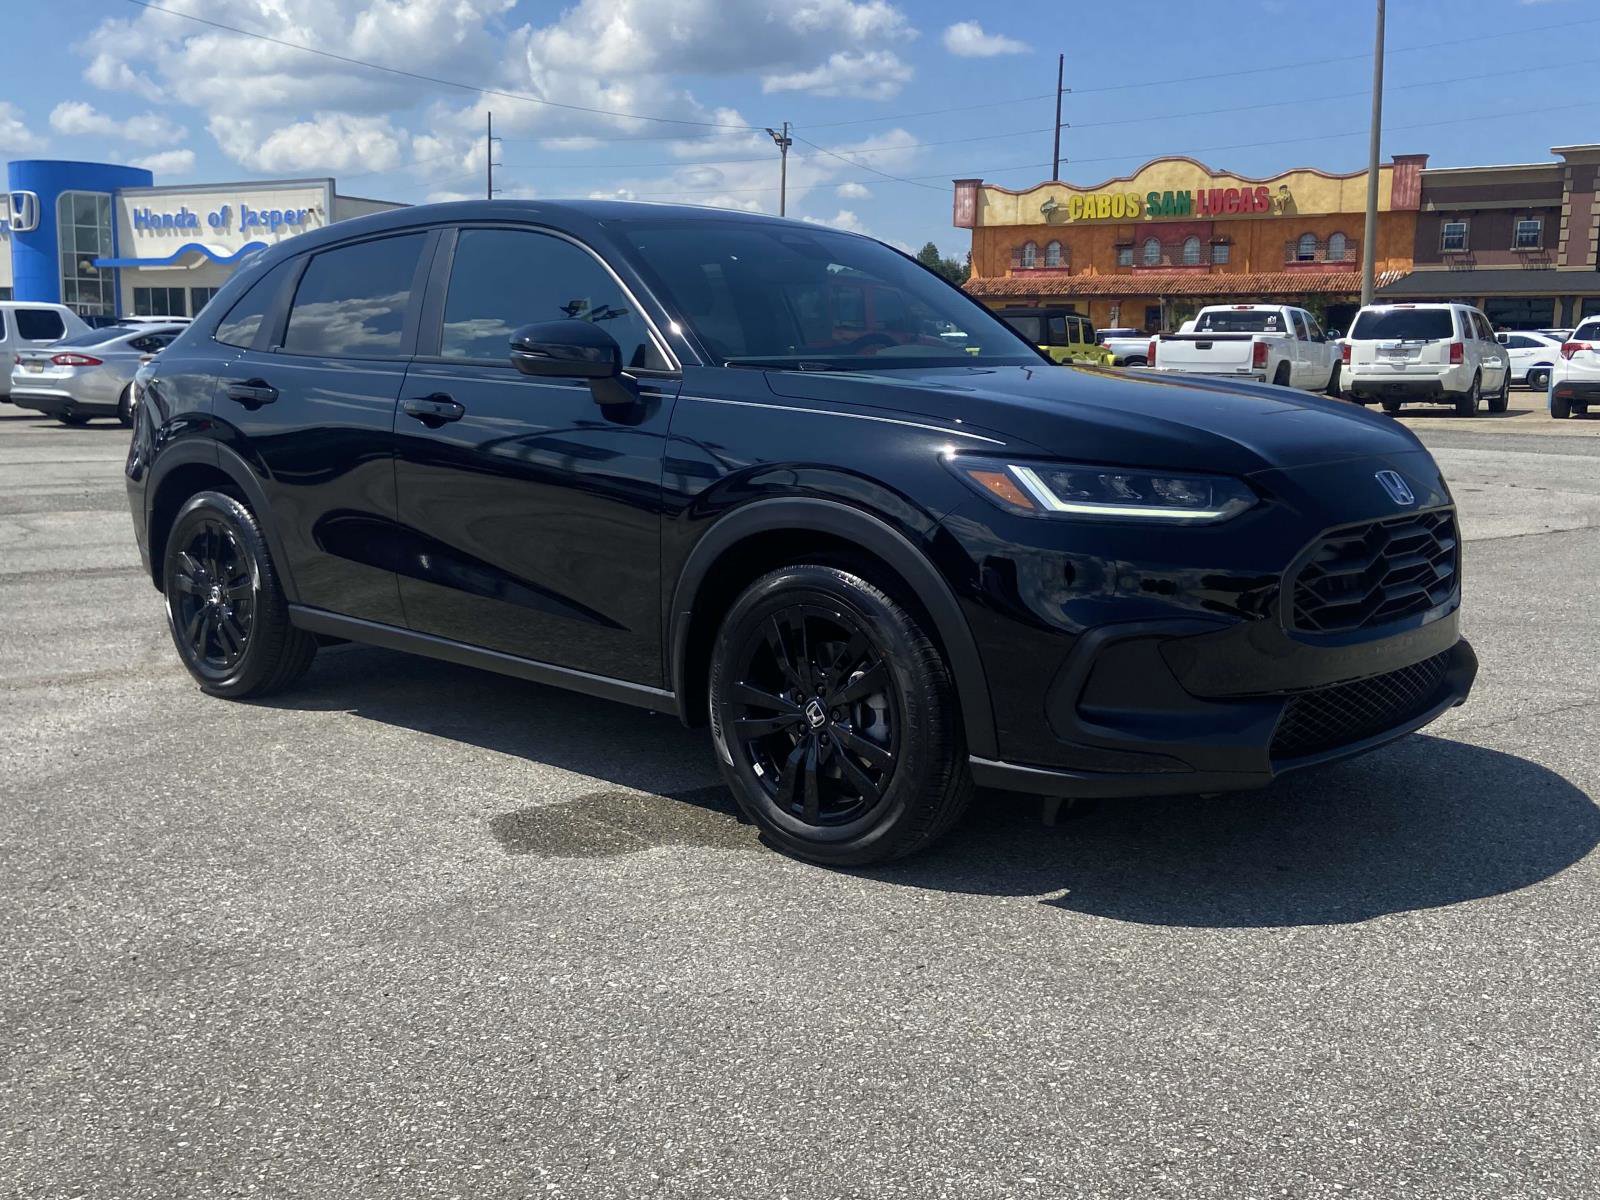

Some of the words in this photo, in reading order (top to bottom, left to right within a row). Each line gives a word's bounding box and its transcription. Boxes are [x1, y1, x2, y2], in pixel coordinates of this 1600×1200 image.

[1069, 192, 1140, 219] CABOS
[1146, 189, 1191, 216] SAN
[1196, 186, 1270, 214] LUCAS
[133, 206, 199, 231] Honda
[207, 204, 230, 229] of
[239, 204, 307, 233] Jasper
